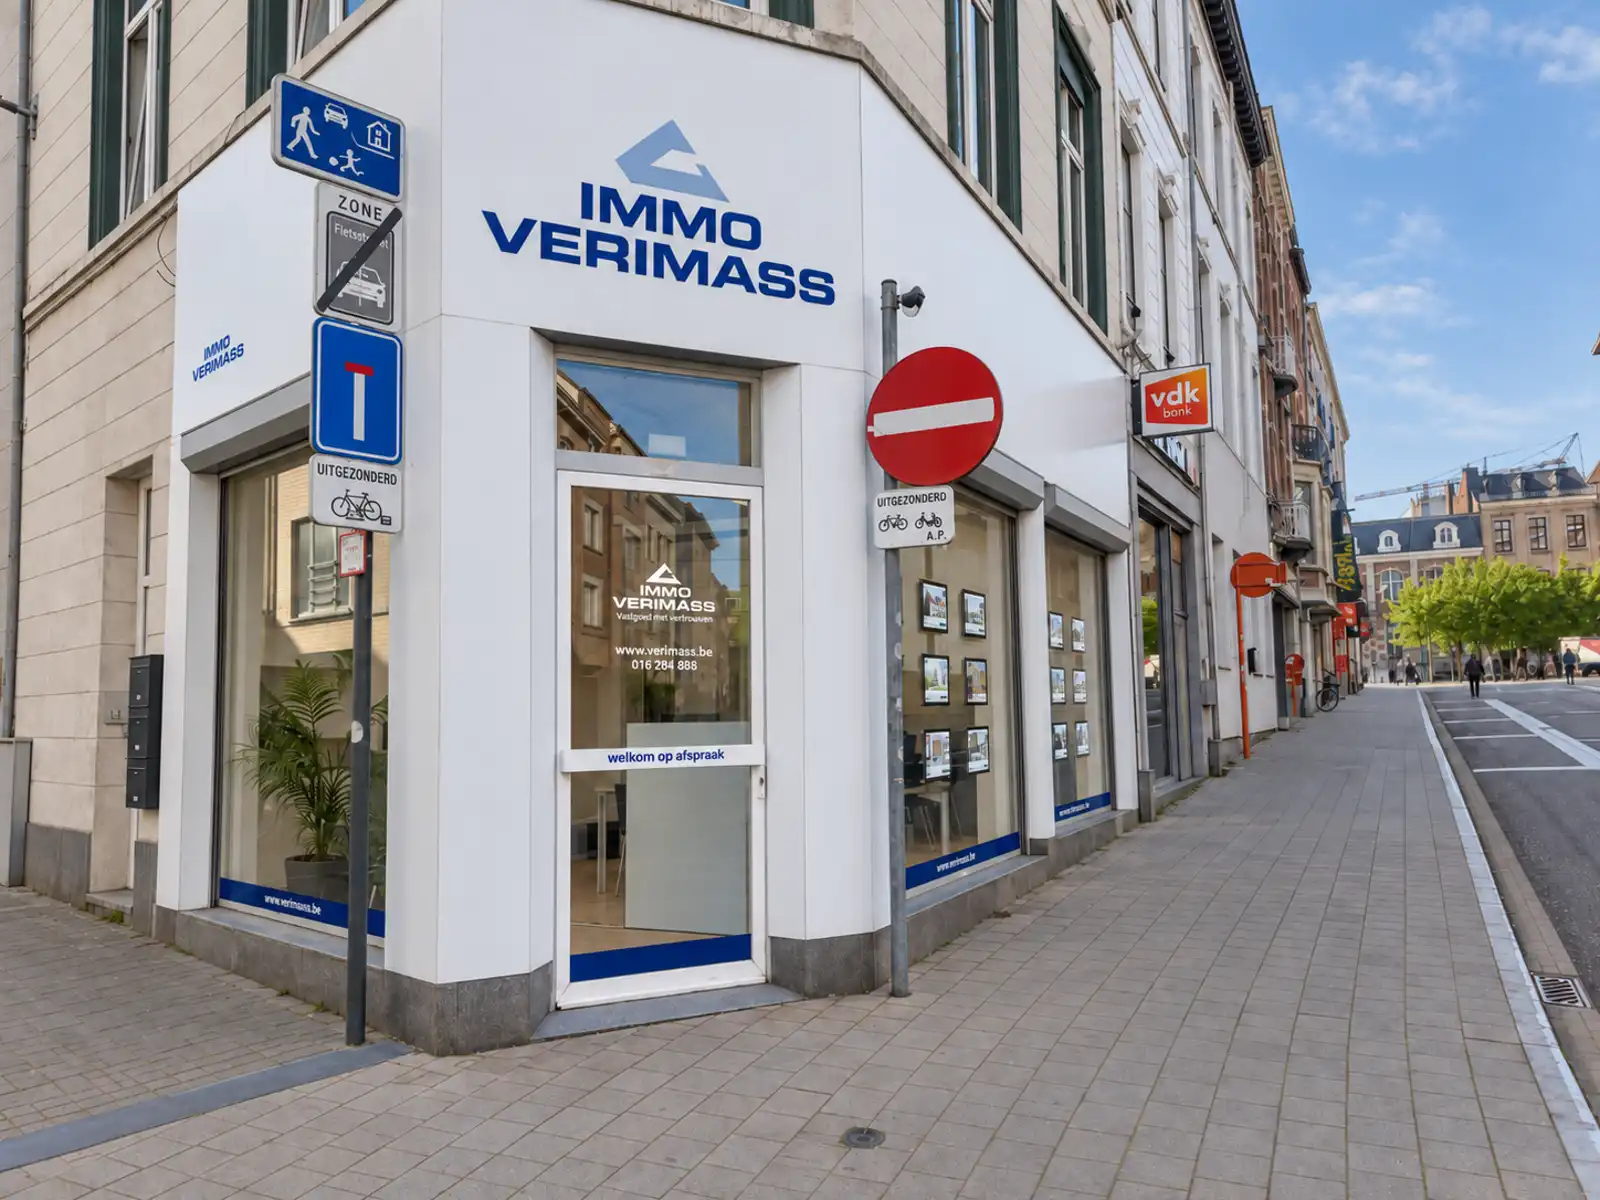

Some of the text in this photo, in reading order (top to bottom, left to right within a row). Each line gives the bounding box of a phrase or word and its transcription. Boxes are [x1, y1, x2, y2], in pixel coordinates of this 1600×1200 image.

[338, 194, 382, 222] ZONE
[580, 181, 762, 251] IMMO
[481, 209, 836, 306] VERIMASS
[203, 334, 231, 361] IMMO
[192, 343, 244, 382] VERIMASS
[1150, 381, 1200, 408] vdk
[1163, 407, 1193, 419] bank
[317, 462, 398, 486] UITGEZONDERD
[877, 491, 947, 508] UITGEZONDERD
[926, 530, 947, 541] A.P.
[639, 584, 691, 598] IMMO
[612, 596, 716, 613] VERIMASS
[616, 612, 652, 623] Vastgoed
[653, 613, 668, 622] met
[615, 644, 713, 657] www.verimass.be
[631, 659, 698, 671] 016 284 888
[607, 749, 725, 764] welkom op afspraak
